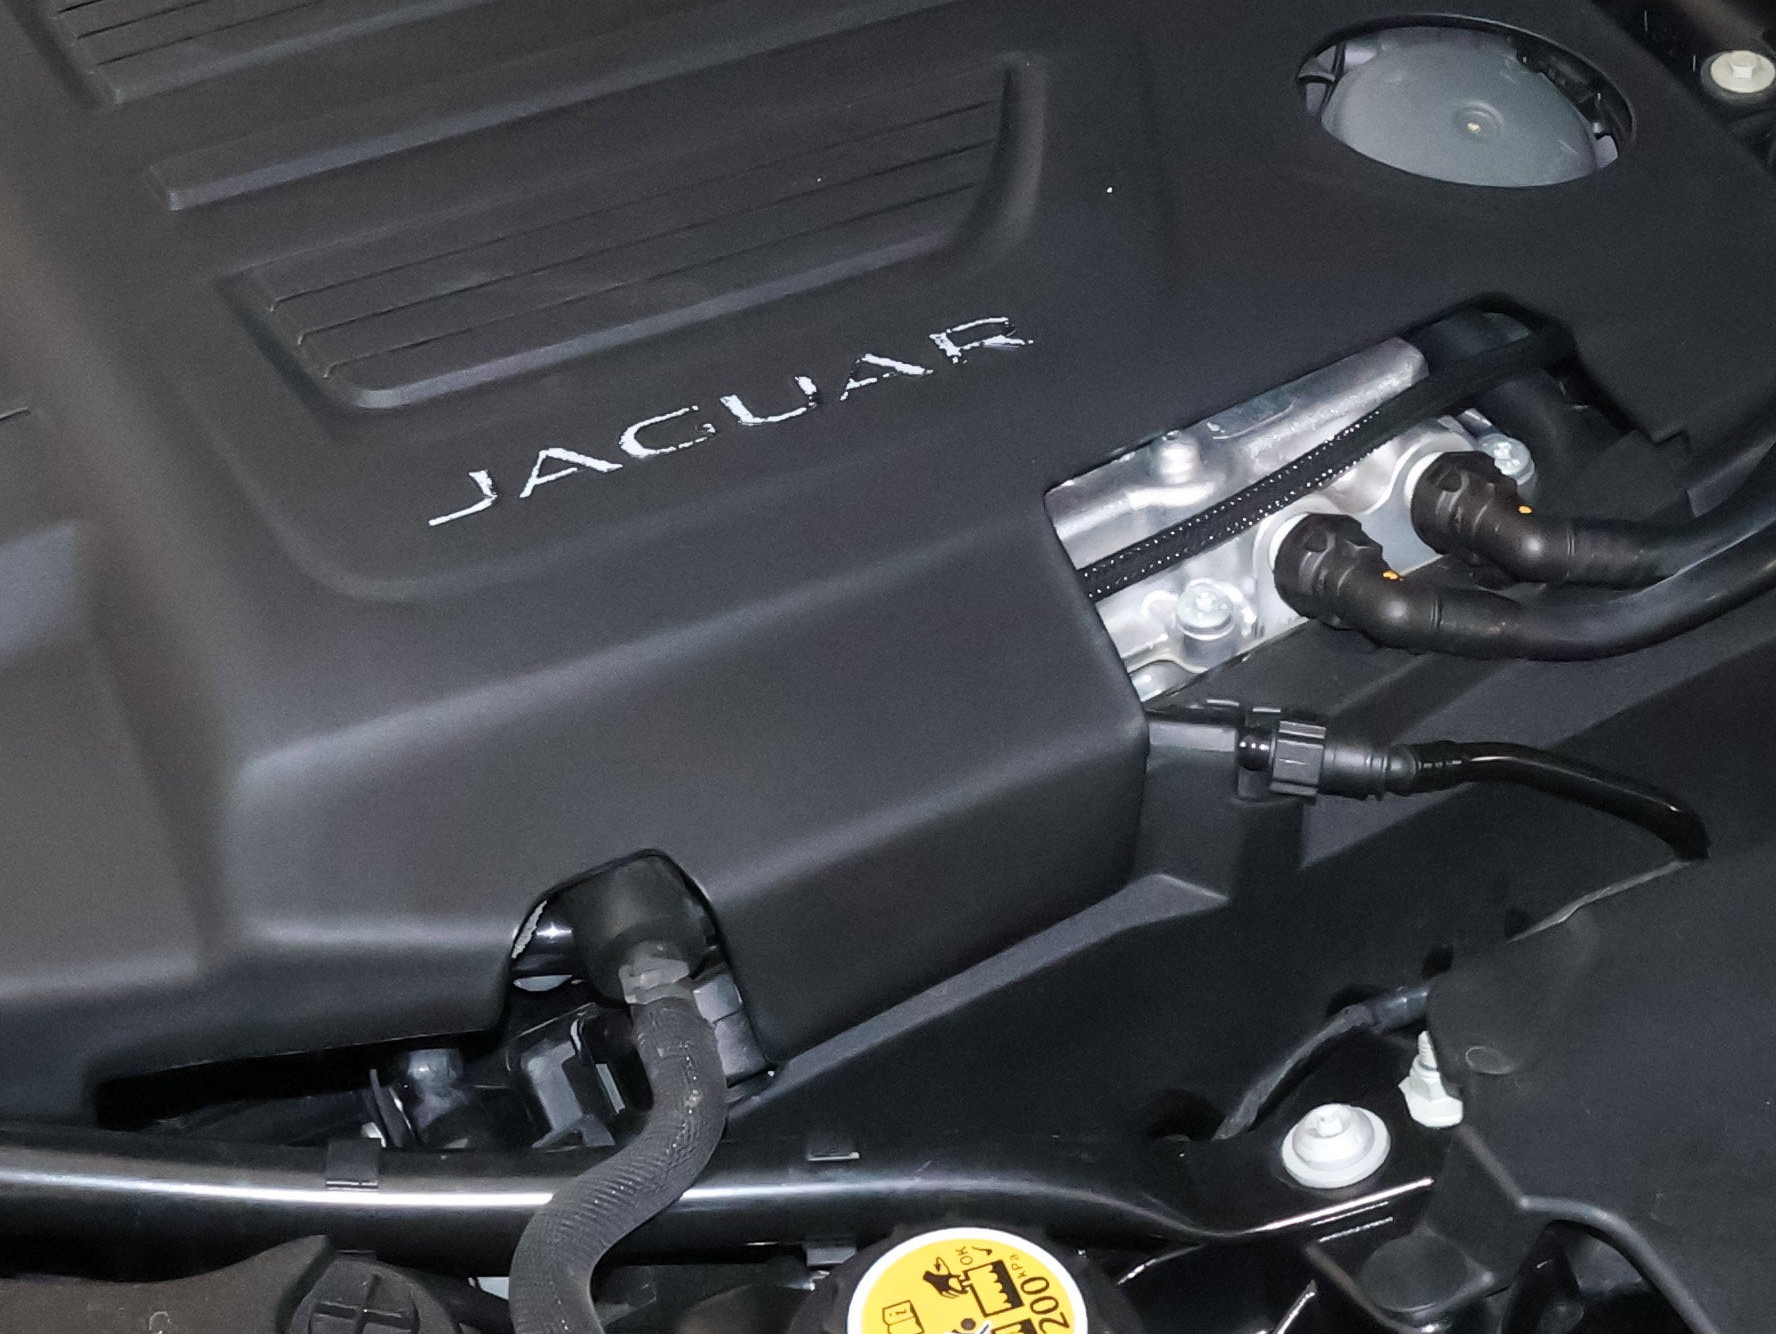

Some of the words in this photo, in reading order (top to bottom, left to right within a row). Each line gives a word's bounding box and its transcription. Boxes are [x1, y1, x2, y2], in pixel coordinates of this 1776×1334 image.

[428, 316, 1034, 525] JAGUAR
[955, 1246, 974, 1266] OK
[1020, 1275, 1070, 1334] 200
